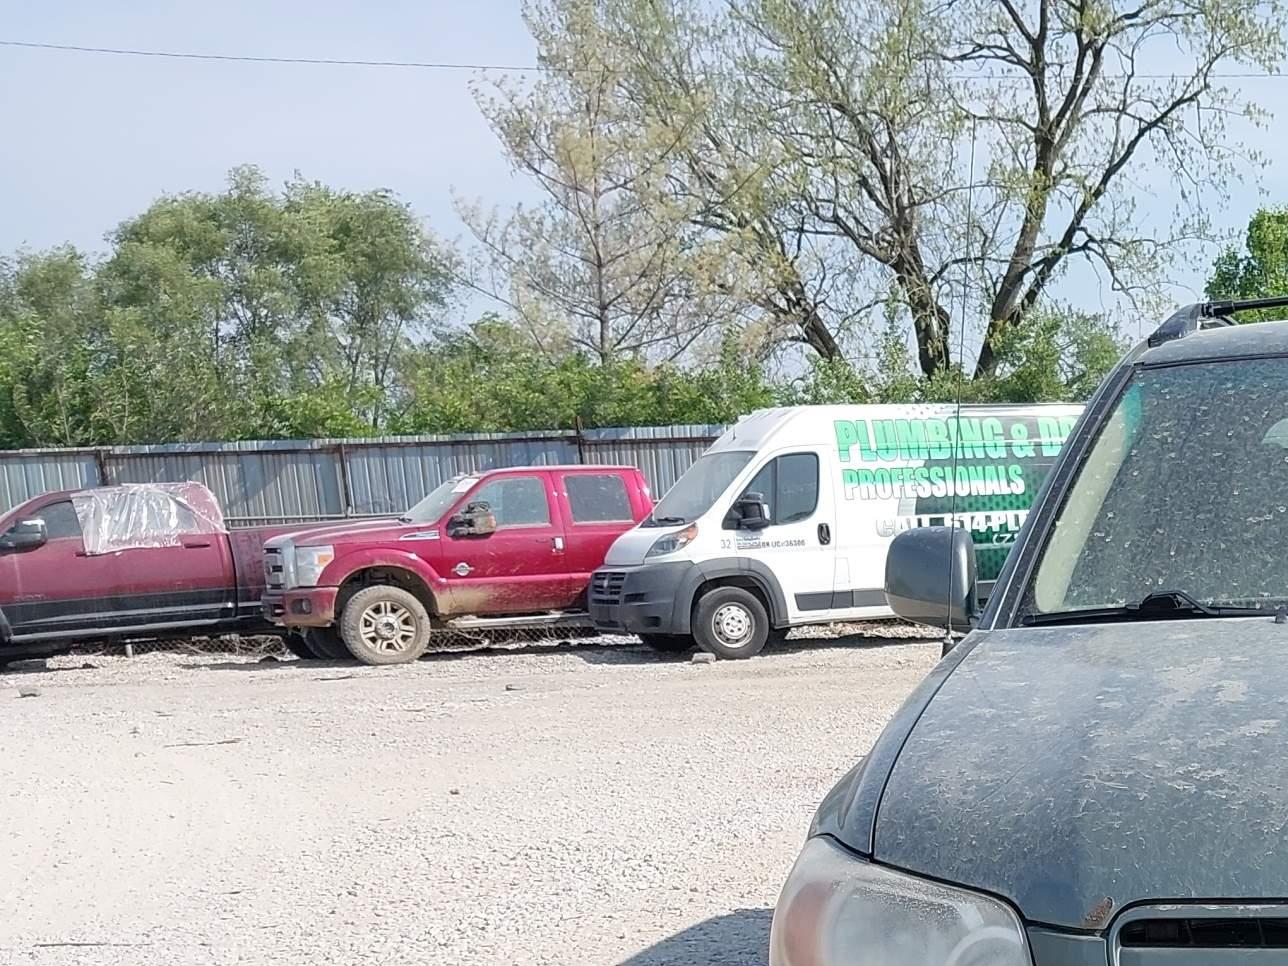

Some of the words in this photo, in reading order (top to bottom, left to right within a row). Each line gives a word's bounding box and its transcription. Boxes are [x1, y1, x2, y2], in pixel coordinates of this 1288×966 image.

[834, 417, 1005, 462] PLUMBING
[1010, 423, 1036, 459] &
[843, 465, 1025, 499] PROFESSIONALS
